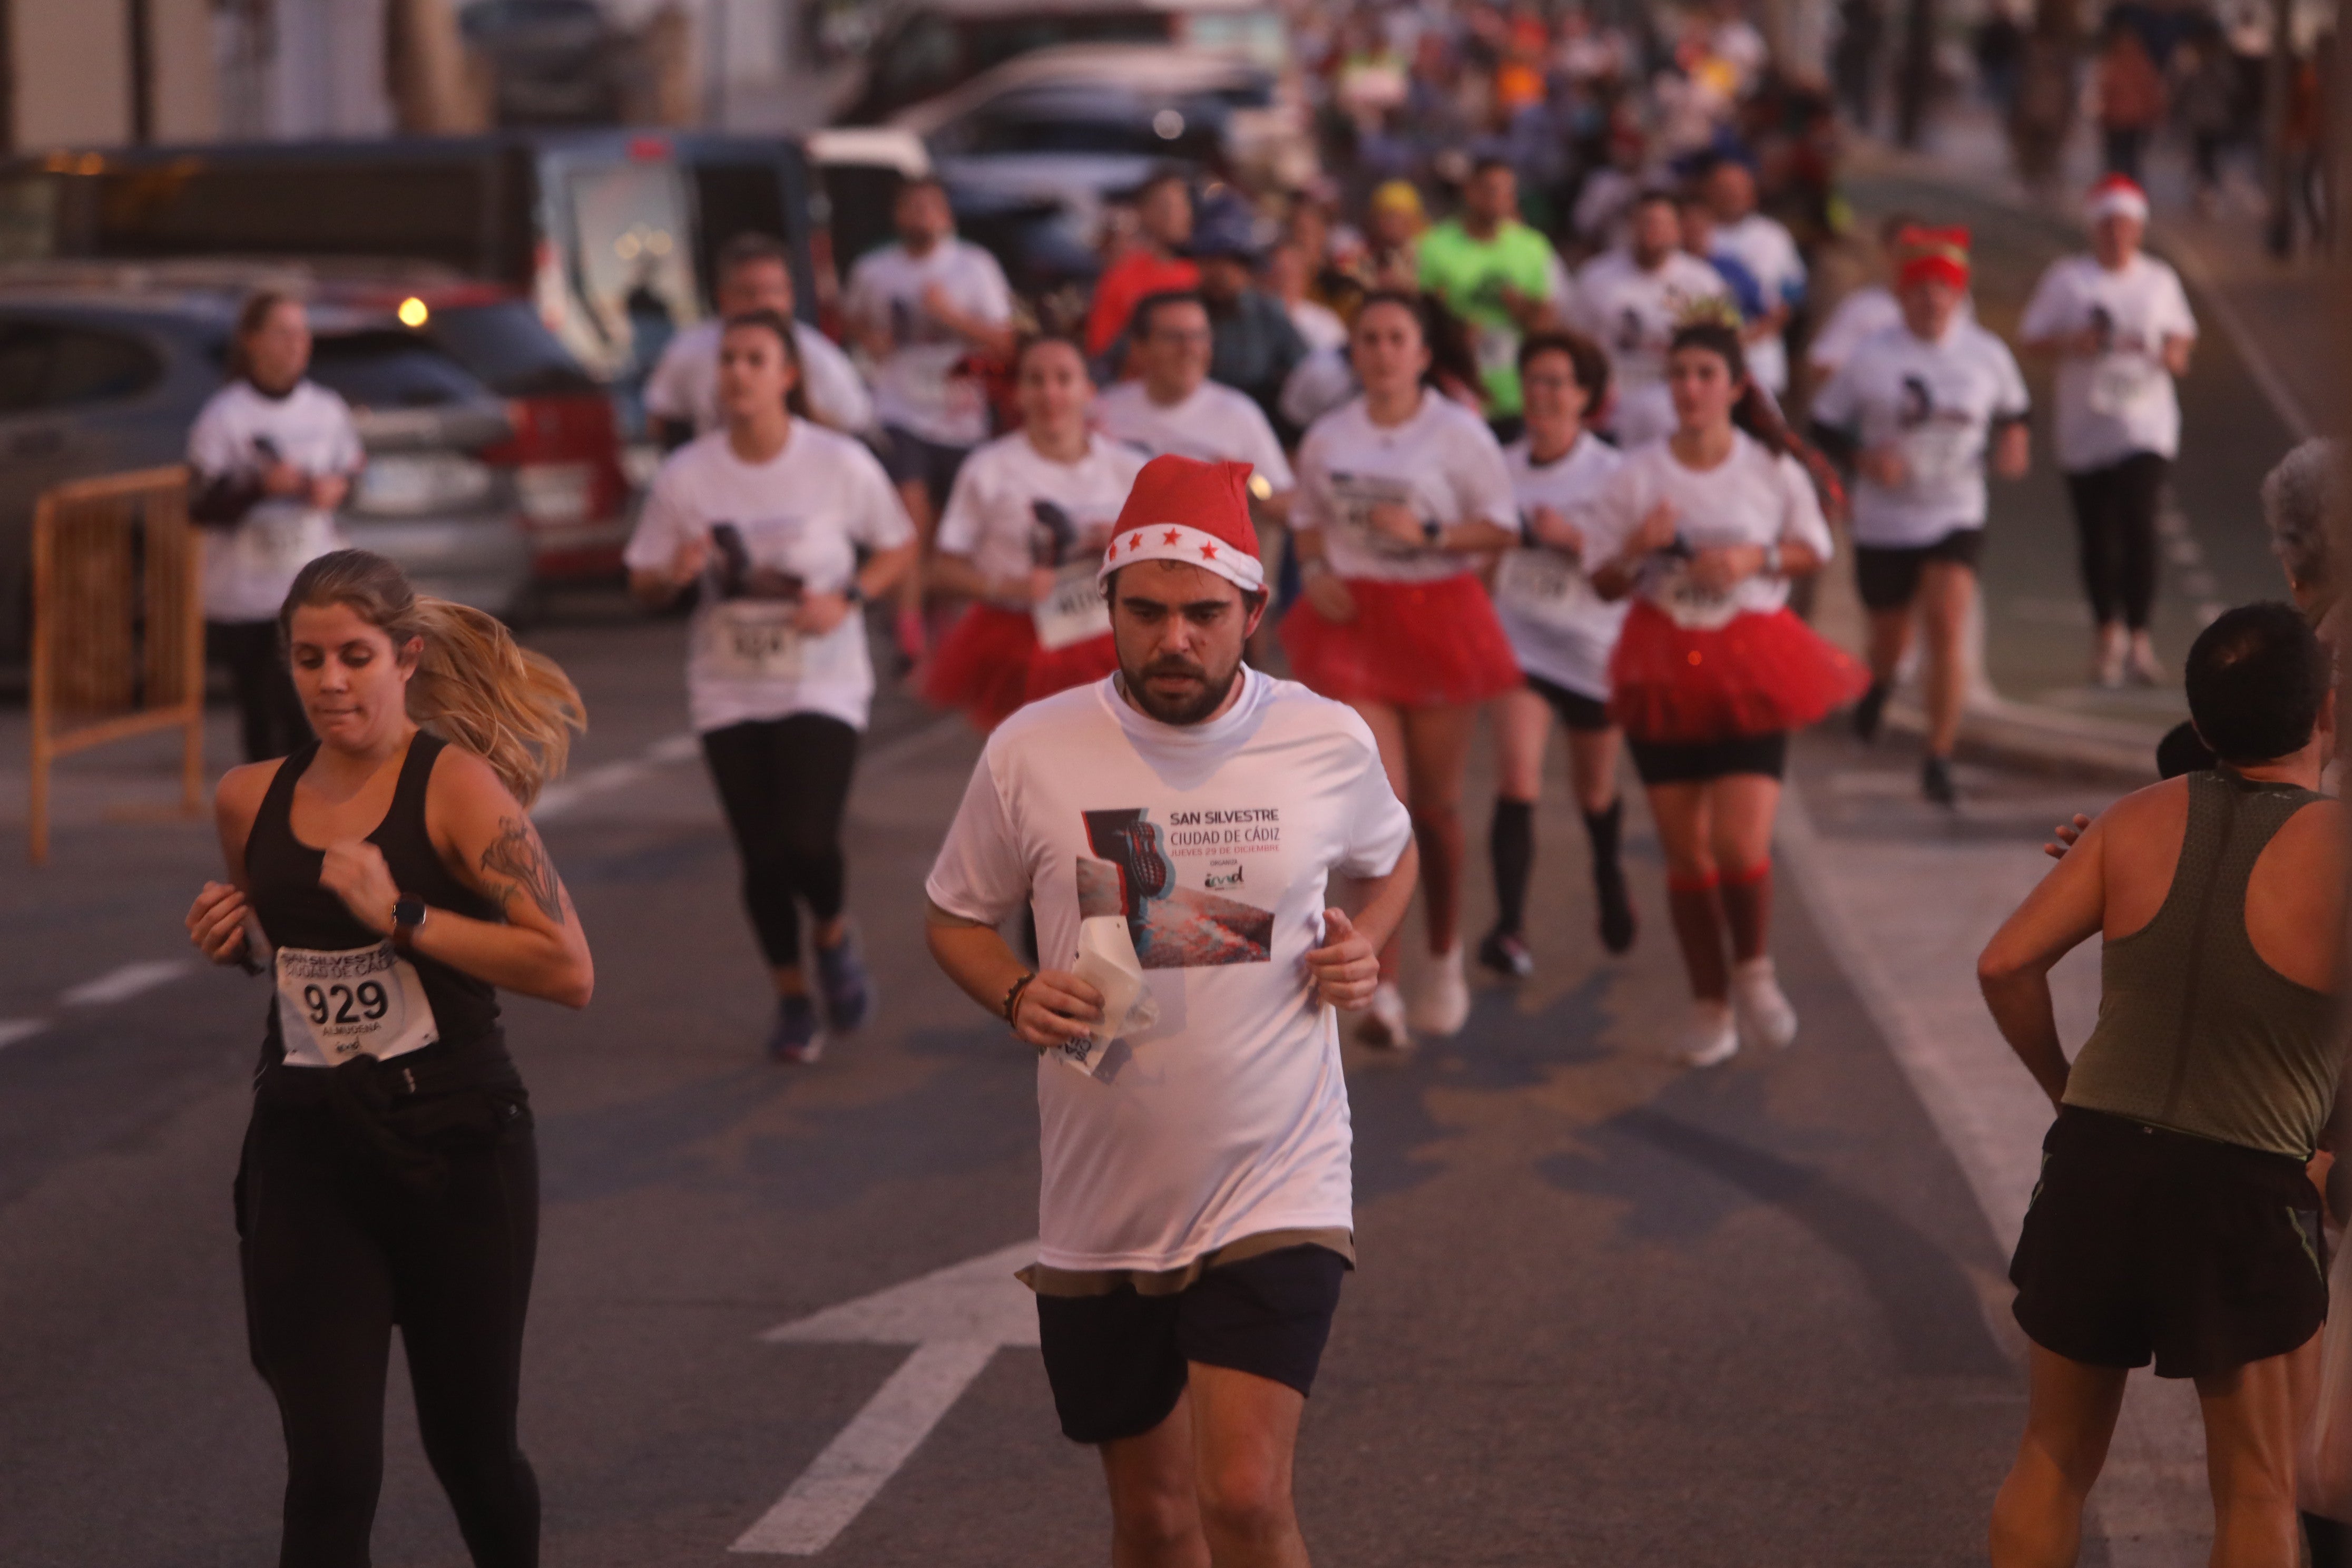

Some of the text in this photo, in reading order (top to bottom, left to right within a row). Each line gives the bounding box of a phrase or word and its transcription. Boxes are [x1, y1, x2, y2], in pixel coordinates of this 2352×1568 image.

[1170, 809, 1279, 826] SAN SILVESTRE
[1170, 826, 1280, 845] CIUDAD DE CÁDIZ
[1171, 844, 1280, 857] JUEVES 29 DE DICIEMBRE
[1210, 858, 1238, 867] ORGANIZA
[303, 980, 389, 1024] 929
